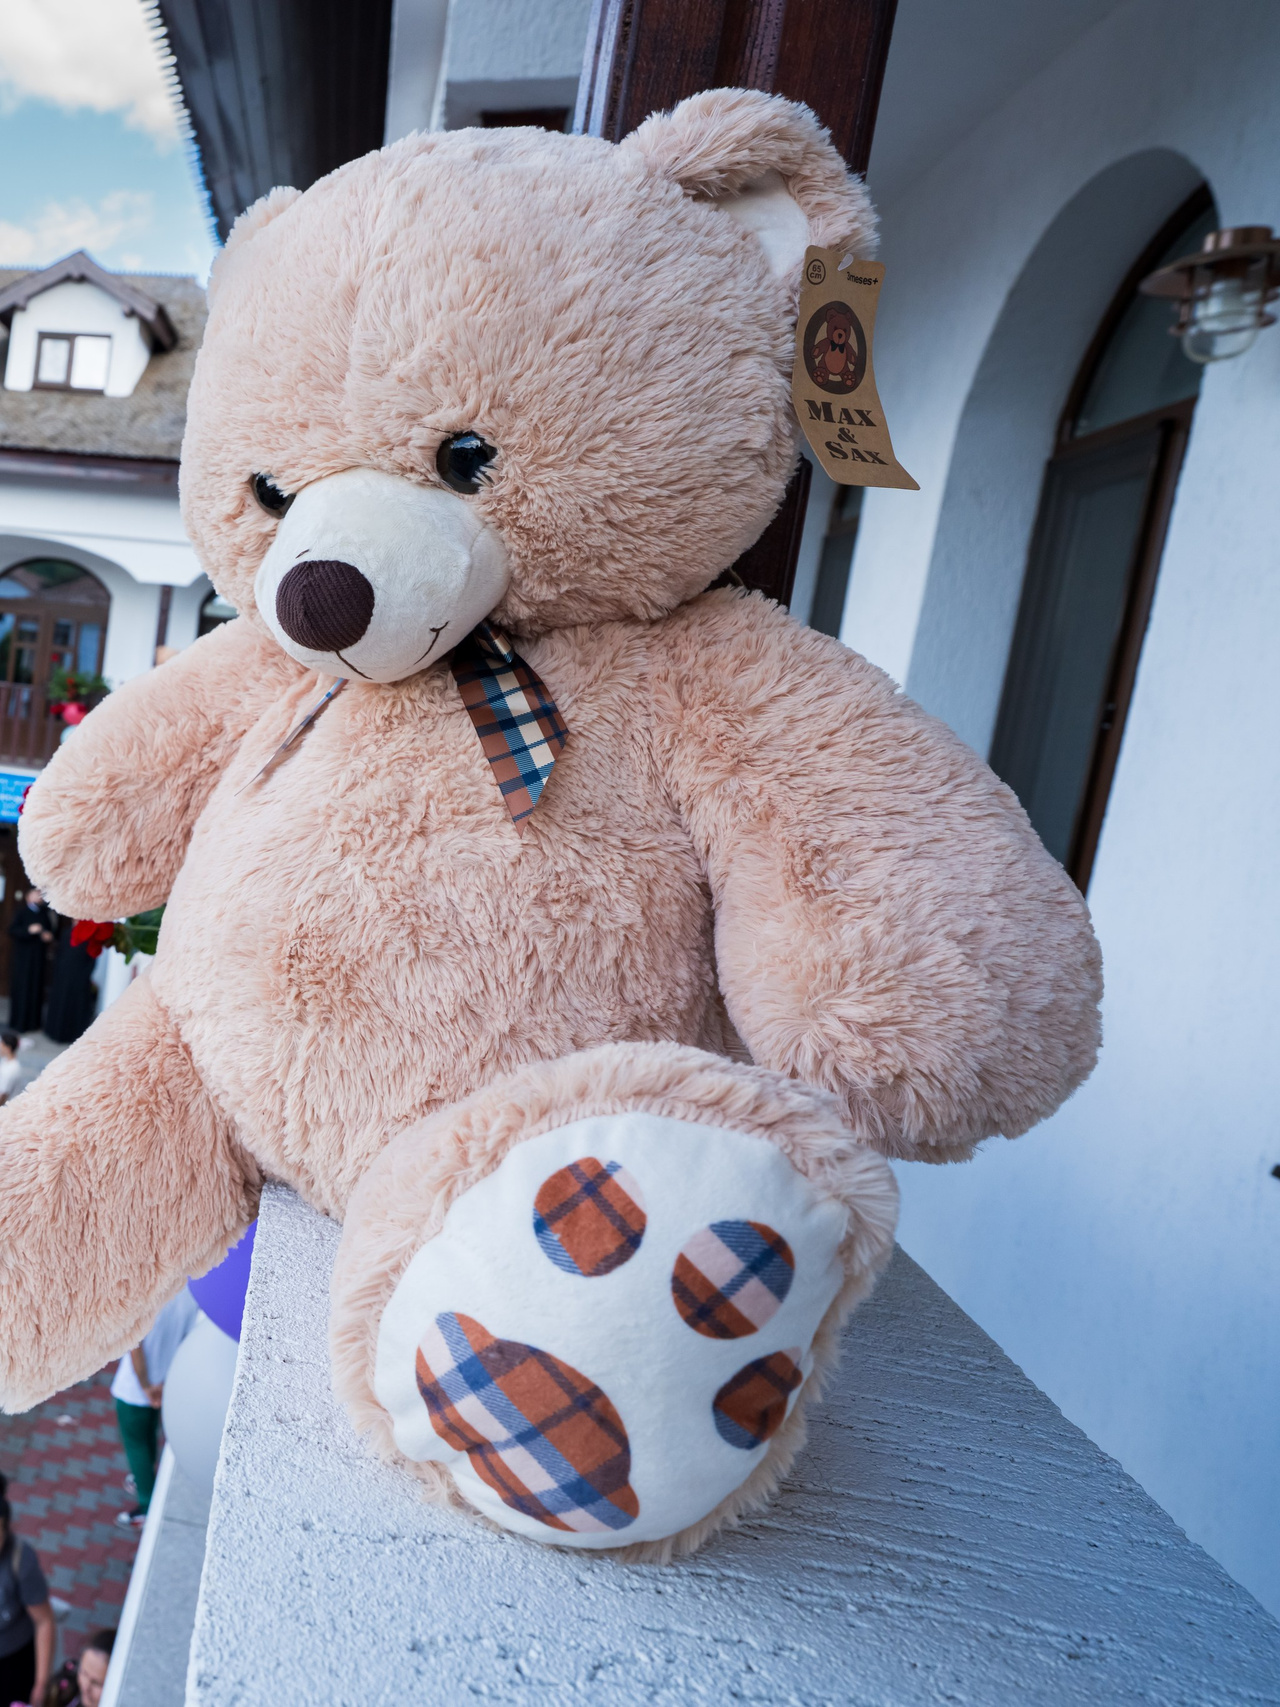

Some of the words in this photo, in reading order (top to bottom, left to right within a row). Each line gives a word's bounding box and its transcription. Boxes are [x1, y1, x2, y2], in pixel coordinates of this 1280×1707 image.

[812, 264, 822, 272] 65
[809, 272, 822, 280] cm
[837, 427, 859, 445] &
